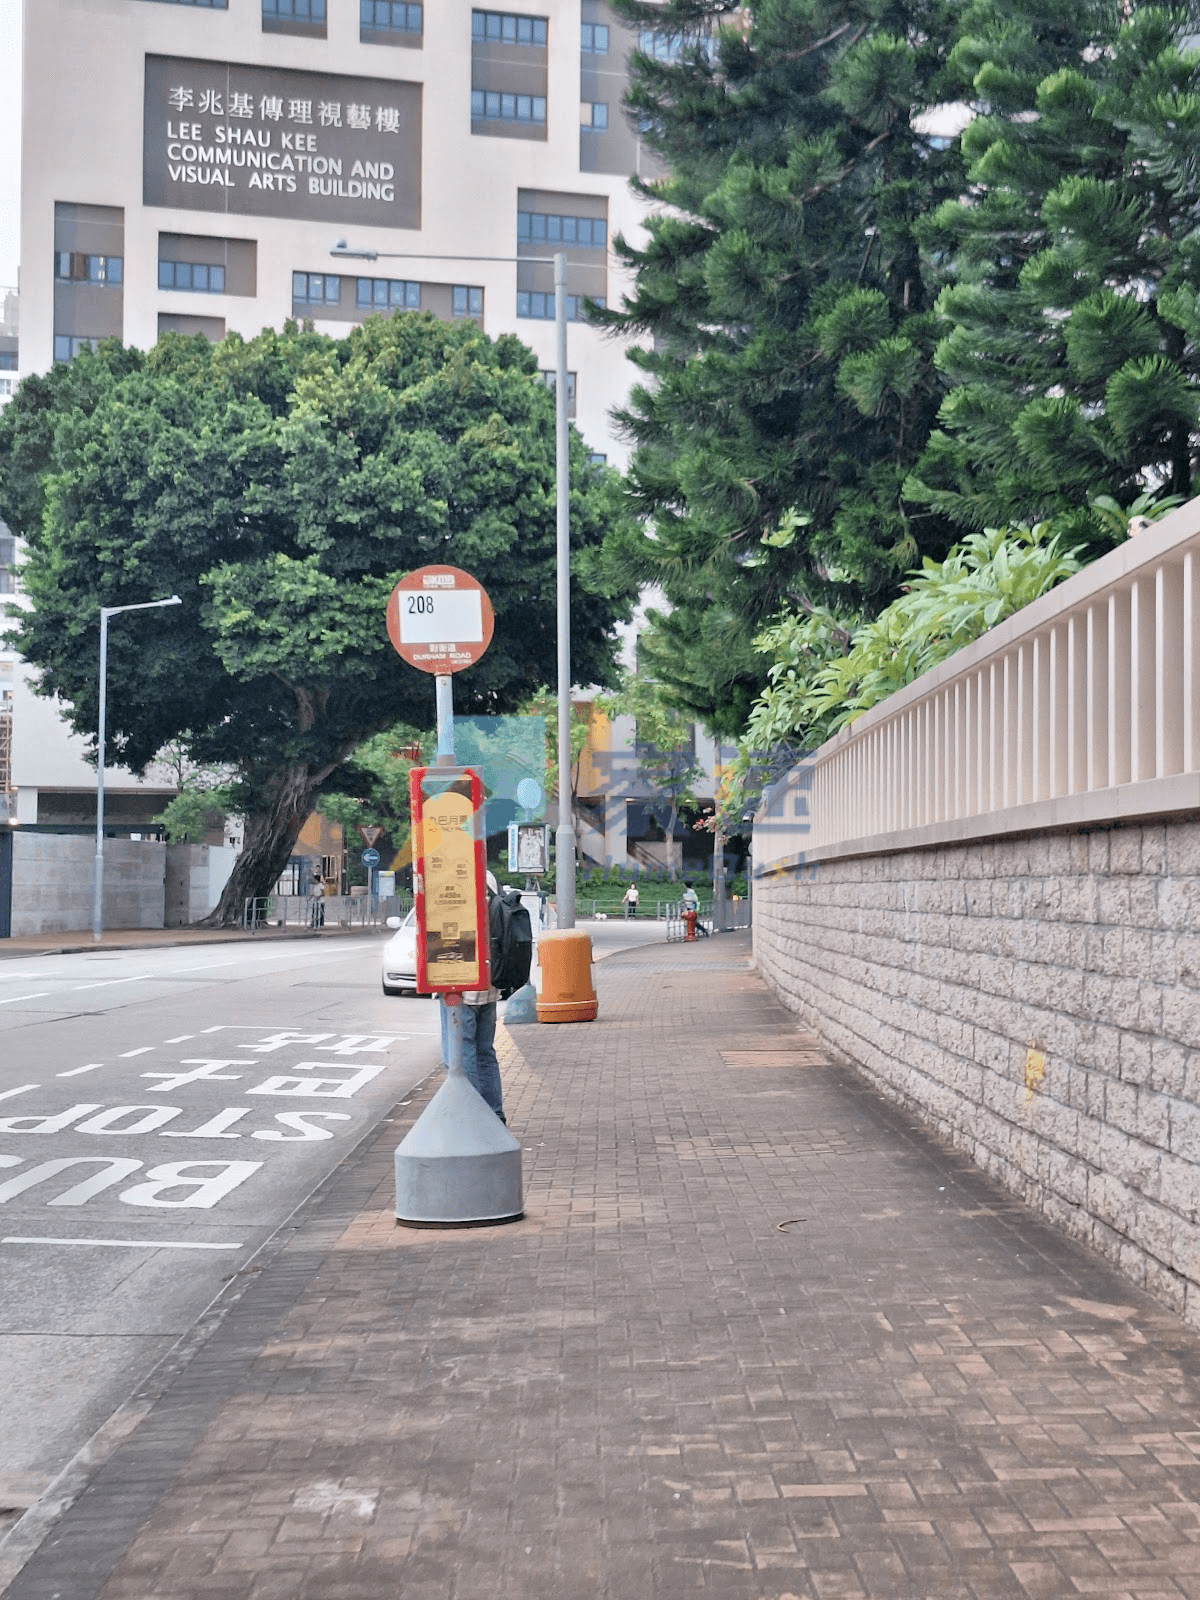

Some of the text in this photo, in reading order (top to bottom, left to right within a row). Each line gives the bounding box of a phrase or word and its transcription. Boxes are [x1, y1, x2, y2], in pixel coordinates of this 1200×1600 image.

[168, 86, 400, 134] 李兆基傳理視藝樓
[167, 122, 318, 152] LEE SHAU KEE
[167, 143, 395, 181] COMMUNICATION AND
[168, 164, 395, 201] VISUAL ARTS BUILDING
[407, 596, 434, 614] 208
[238, 1032, 410, 1055] 站
[140, 1059, 387, 1098] 巴士
[0, 1104, 352, 1141] STOP
[0, 1154, 265, 1208] BU
